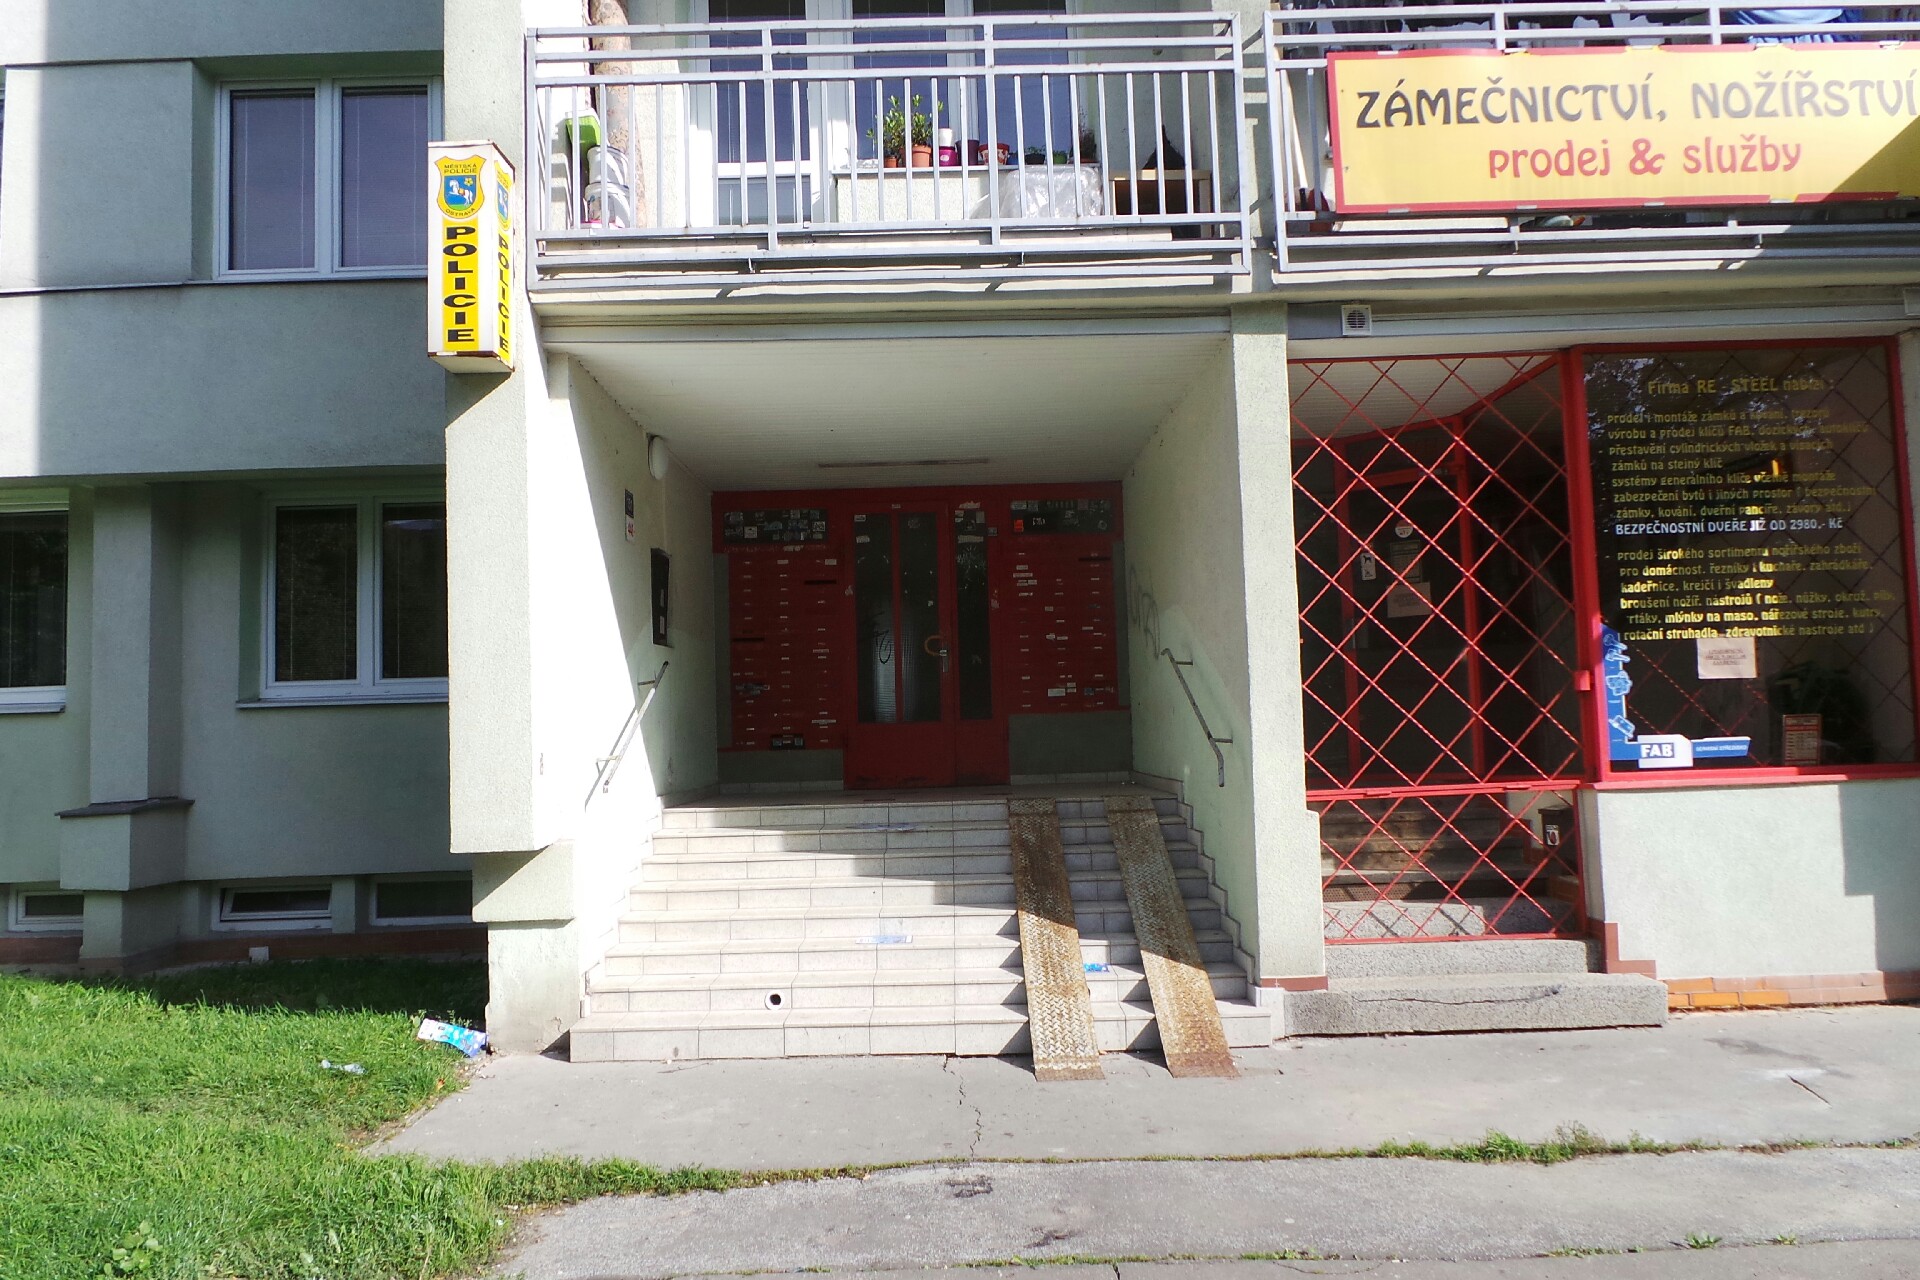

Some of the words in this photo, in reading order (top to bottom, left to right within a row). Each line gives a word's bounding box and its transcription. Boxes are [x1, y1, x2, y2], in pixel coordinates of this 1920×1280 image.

[1356, 72, 1667, 128] ZÁMEČNICTVÍ,
[1691, 68, 1919, 119] NOŽÍŘSTVÍ
[1489, 139, 1611, 179] prodej
[1629, 137, 1666, 176] &
[1682, 133, 1802, 174] služby
[445, 207, 475, 217] OSTRAVA
[442, 226, 478, 342] POLICIE
[497, 233, 510, 354] POLICIE
[1648, 381, 1689, 394] Firma
[1697, 380, 1717, 393] RE
[1731, 378, 1779, 392] STEEL
[1654, 412, 1698, 423] montáže
[1608, 429, 1647, 441] výrobu
[1650, 429, 1656, 439] a
[1660, 428, 1696, 439] prodej
[1609, 442, 1667, 455] přestavění
[1669, 440, 1741, 453] cylindrických
[1611, 459, 1647, 471] zámků
[1651, 460, 1664, 470] na
[1668, 458, 1700, 470] stejný
[1704, 457, 1724, 468] klíč
[1612, 475, 1657, 487] systémy
[1613, 489, 1679, 502] zabezpečení
[1682, 487, 1705, 500] bytů
[1715, 486, 1749, 499] jiných
[1752, 487, 1793, 499] prostor
[1700, 504, 1736, 516] dveřní
[1615, 519, 1705, 534] BEZPEČNOSTNÍ
[1708, 517, 1749, 531] DVEŘE
[1750, 517, 1767, 531] JIŽ
[1769, 520, 1787, 531] OD
[1828, 517, 1844, 529] Kč
[1617, 550, 1654, 562] prodej
[1657, 548, 1705, 560] širokého
[1619, 567, 1639, 578] pro
[1709, 562, 1750, 574] řezníky
[1683, 578, 1715, 591] krejčí
[1725, 577, 1775, 589] švadleny
[1620, 596, 1670, 609] broušení
[1706, 593, 1754, 606] nástrojů
[1664, 610, 1704, 623] mlýnky
[1706, 612, 1721, 623] na
[1761, 608, 1810, 620] nářezové
[1624, 629, 1665, 641] rotační
[1725, 625, 1796, 638] zdravotnické
[1640, 743, 1674, 758] FAB
